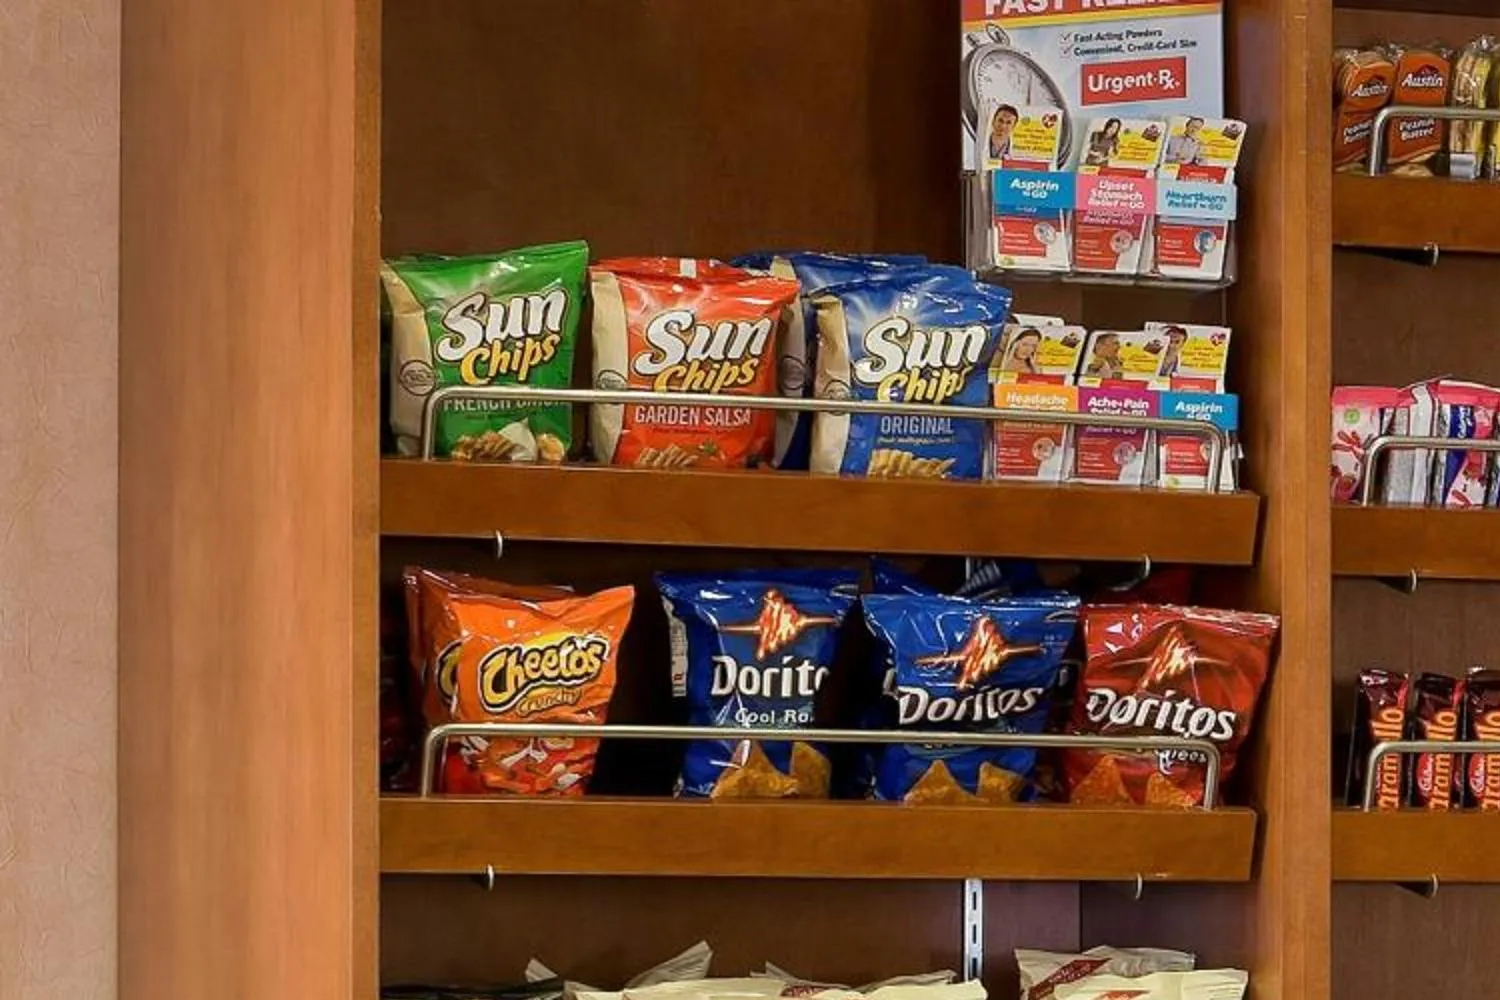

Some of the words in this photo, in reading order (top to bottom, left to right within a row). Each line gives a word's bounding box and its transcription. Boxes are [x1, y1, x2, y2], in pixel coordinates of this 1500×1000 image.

[1351, 83, 1389, 97] Austin
[1401, 73, 1443, 87] Austin
[1011, 178, 1059, 192] Aspirin
[436, 290, 568, 361] Sun
[635, 311, 771, 374] Sun
[460, 334, 560, 384] Chips
[854, 319, 988, 384] Sun
[654, 357, 759, 393] Chips
[635, 405, 699, 425] GARDEN
[704, 408, 751, 426] SALSA
[881, 416, 953, 435] ORIGINAL
[1174, 401, 1223, 415] Aspirin
[482, 637, 607, 706] Cheetos
[898, 686, 1044, 725] Doritos
[1086, 688, 1236, 741] Doritos
[1426, 710, 1456, 811] aramllo
